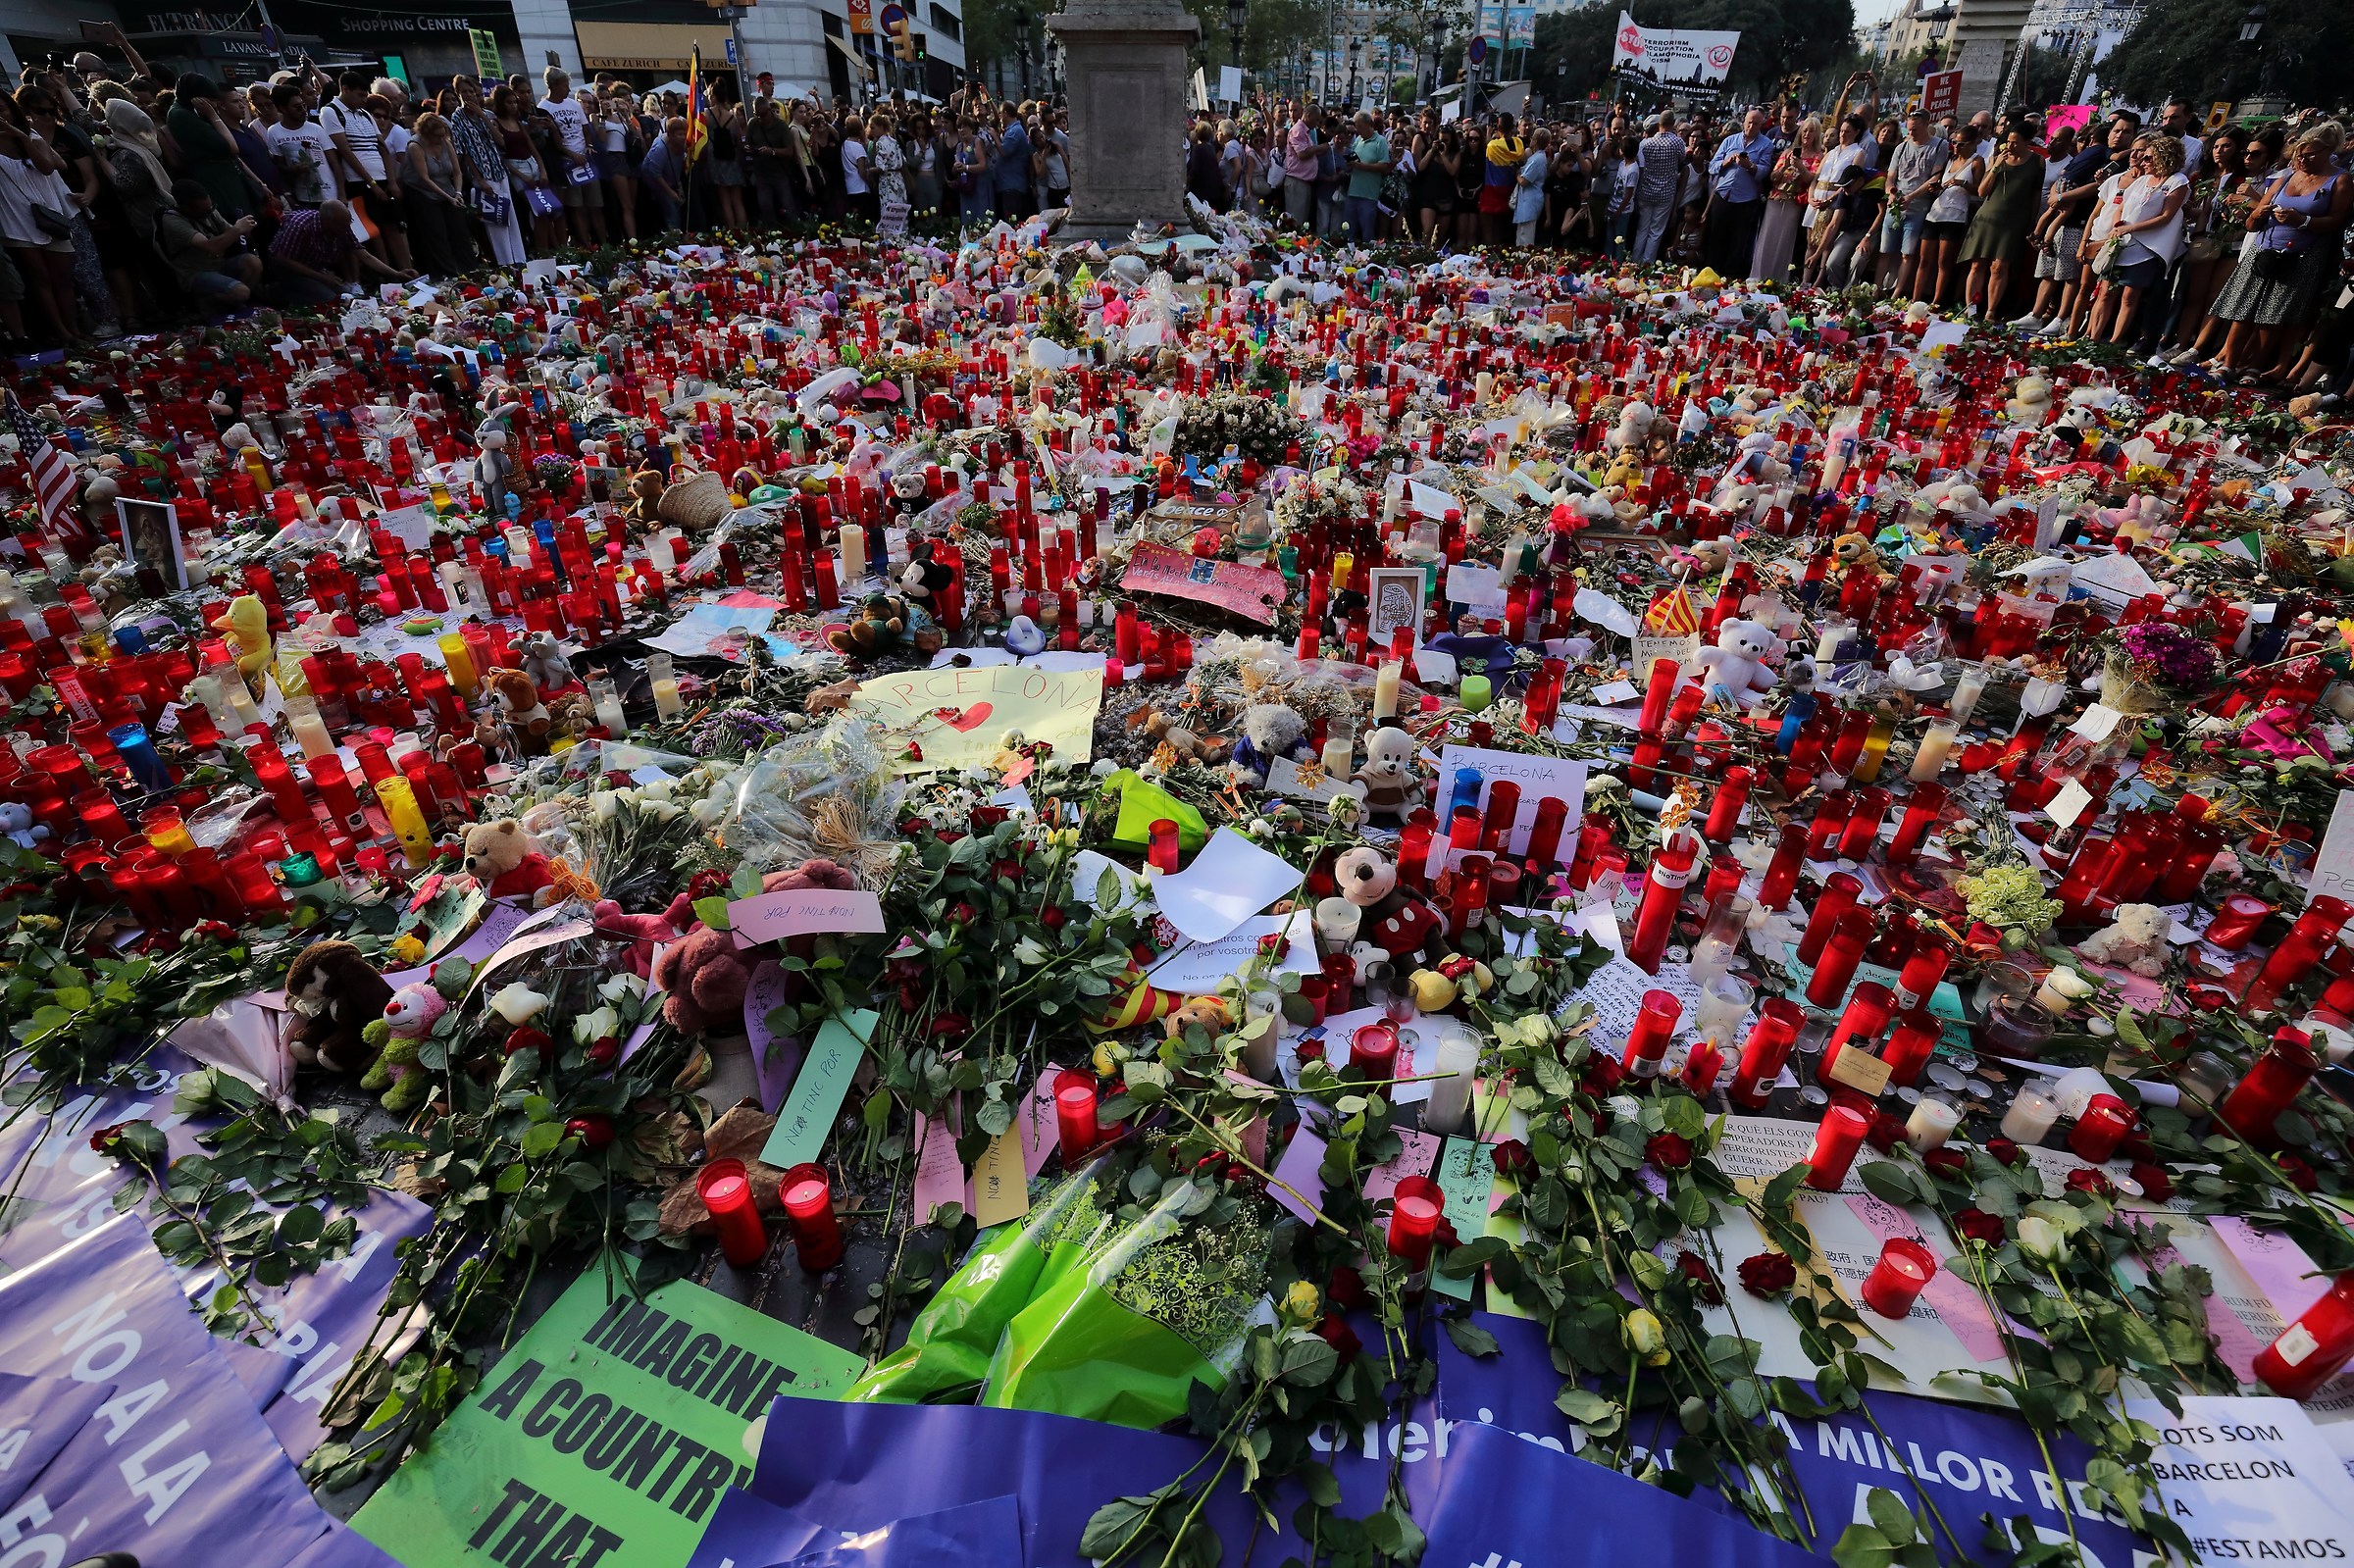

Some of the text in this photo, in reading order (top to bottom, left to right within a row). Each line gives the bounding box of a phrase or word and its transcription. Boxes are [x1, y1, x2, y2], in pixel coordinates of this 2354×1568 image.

[340, 16, 470, 31] SHOPPING CENTRE
[1940, 76, 1950, 86] WE
[1934, 86, 1952, 98] WANT
[1930, 98, 1950, 111] PEACE
[1638, 638, 1691, 648] TENEMOS
[1450, 752, 1557, 782] BARCELONA
[764, 905, 792, 920] POR
[1197, 945, 1258, 960] por vosotro
[801, 1081, 824, 1113] TINC
[820, 1048, 842, 1078] POR
[1737, 1123, 1763, 1134] QUÈ
[1764, 1127, 1785, 1137] ELS
[1719, 1142, 1797, 1159] TERRORISTES
[1799, 1192, 1829, 1205] PAU?
[51, 1290, 143, 1384] NO
[582, 1293, 797, 1422] IMAGINE
[478, 1357, 543, 1421] A
[2220, 1425, 2284, 1442] SOM
[92, 1378, 213, 1528] A LA
[1817, 1420, 2025, 1504] MILLOR
[2151, 1459, 2296, 1482] BARCELON
[2174, 1498, 2194, 1518] A
[467, 1477, 625, 1568] THAT
[2192, 1537, 2347, 1560] #ESTAMOS
